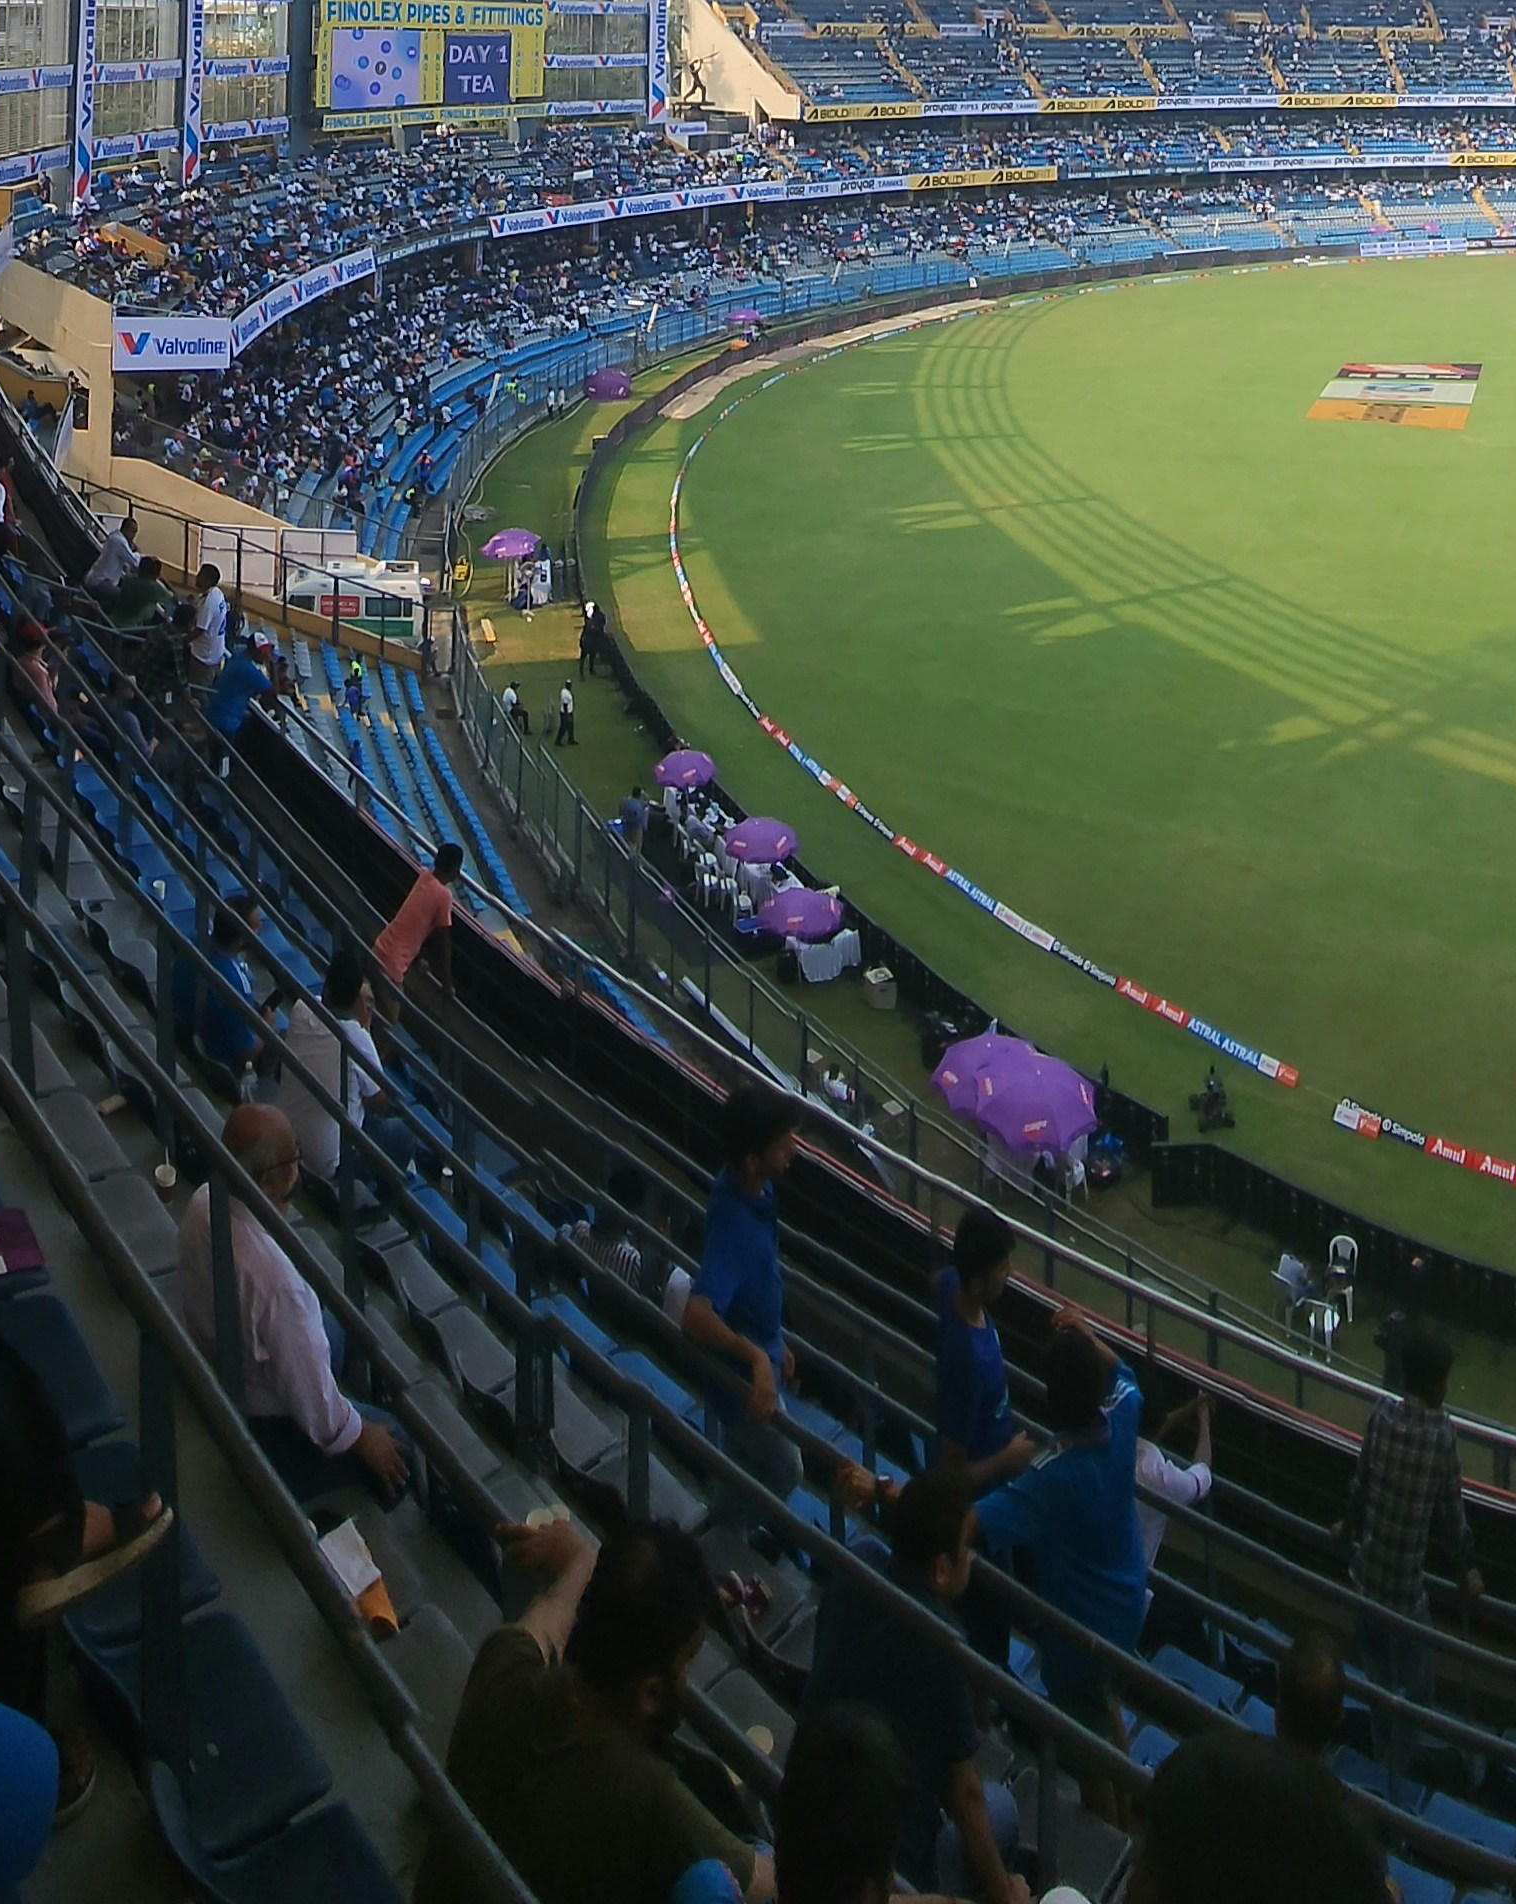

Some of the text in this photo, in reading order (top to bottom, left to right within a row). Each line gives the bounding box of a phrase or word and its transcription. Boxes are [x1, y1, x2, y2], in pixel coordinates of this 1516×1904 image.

[407, 4, 450, 25] PIPES
[455, 6, 466, 25] &
[449, 45, 508, 63] DAY 1
[458, 75, 495, 94] TEA
[346, 257, 373, 278] Valvoline
[1121, 981, 1149, 1005] Amul
[1155, 998, 1184, 1025] Amul
[1187, 1017, 1223, 1045] ASTRAL
[1221, 1037, 1260, 1067] ASTRAL
[1391, 1122, 1425, 1146] Simpolo
[1430, 1137, 1466, 1166] Amul
[1479, 1154, 1516, 1183] Amul
